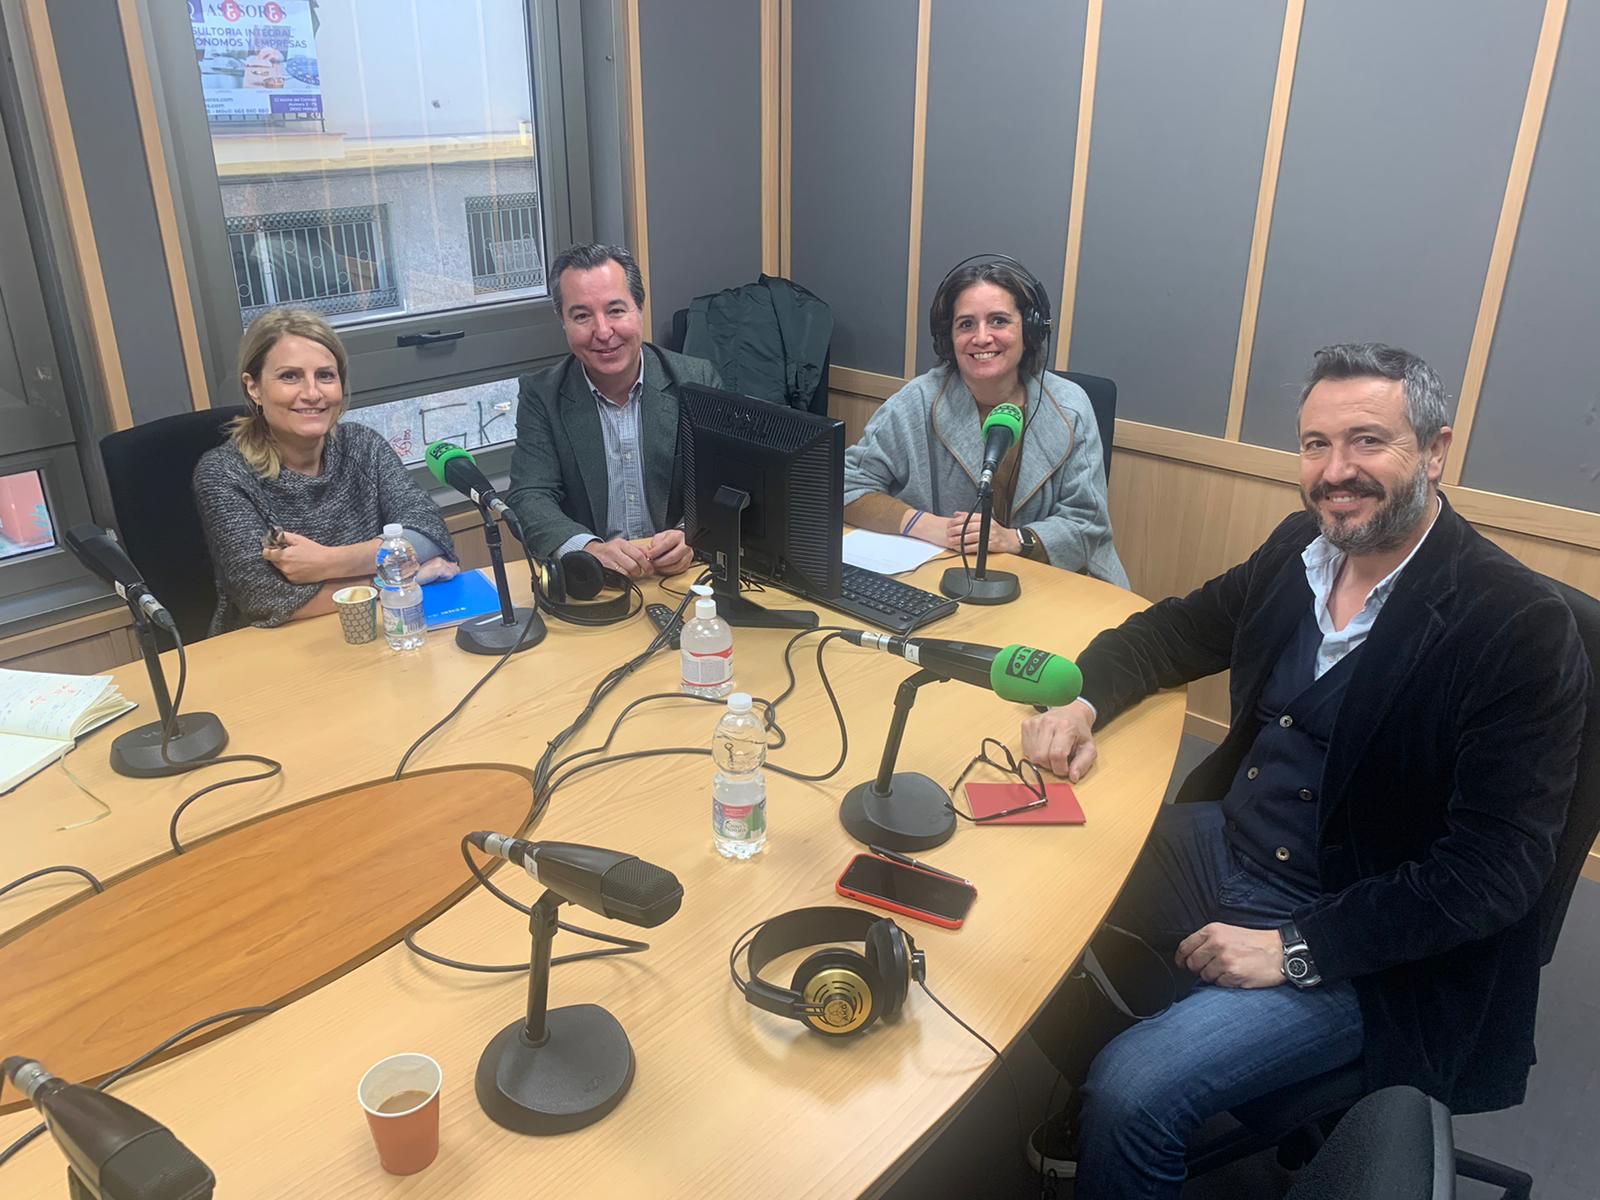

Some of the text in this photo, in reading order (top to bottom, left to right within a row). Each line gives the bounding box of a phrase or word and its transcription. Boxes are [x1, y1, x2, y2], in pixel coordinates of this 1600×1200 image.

[245, 28, 294, 38] INTEGRAL
[245, 39, 252, 47] Y
[255, 40, 307, 48] EMPRESAS
